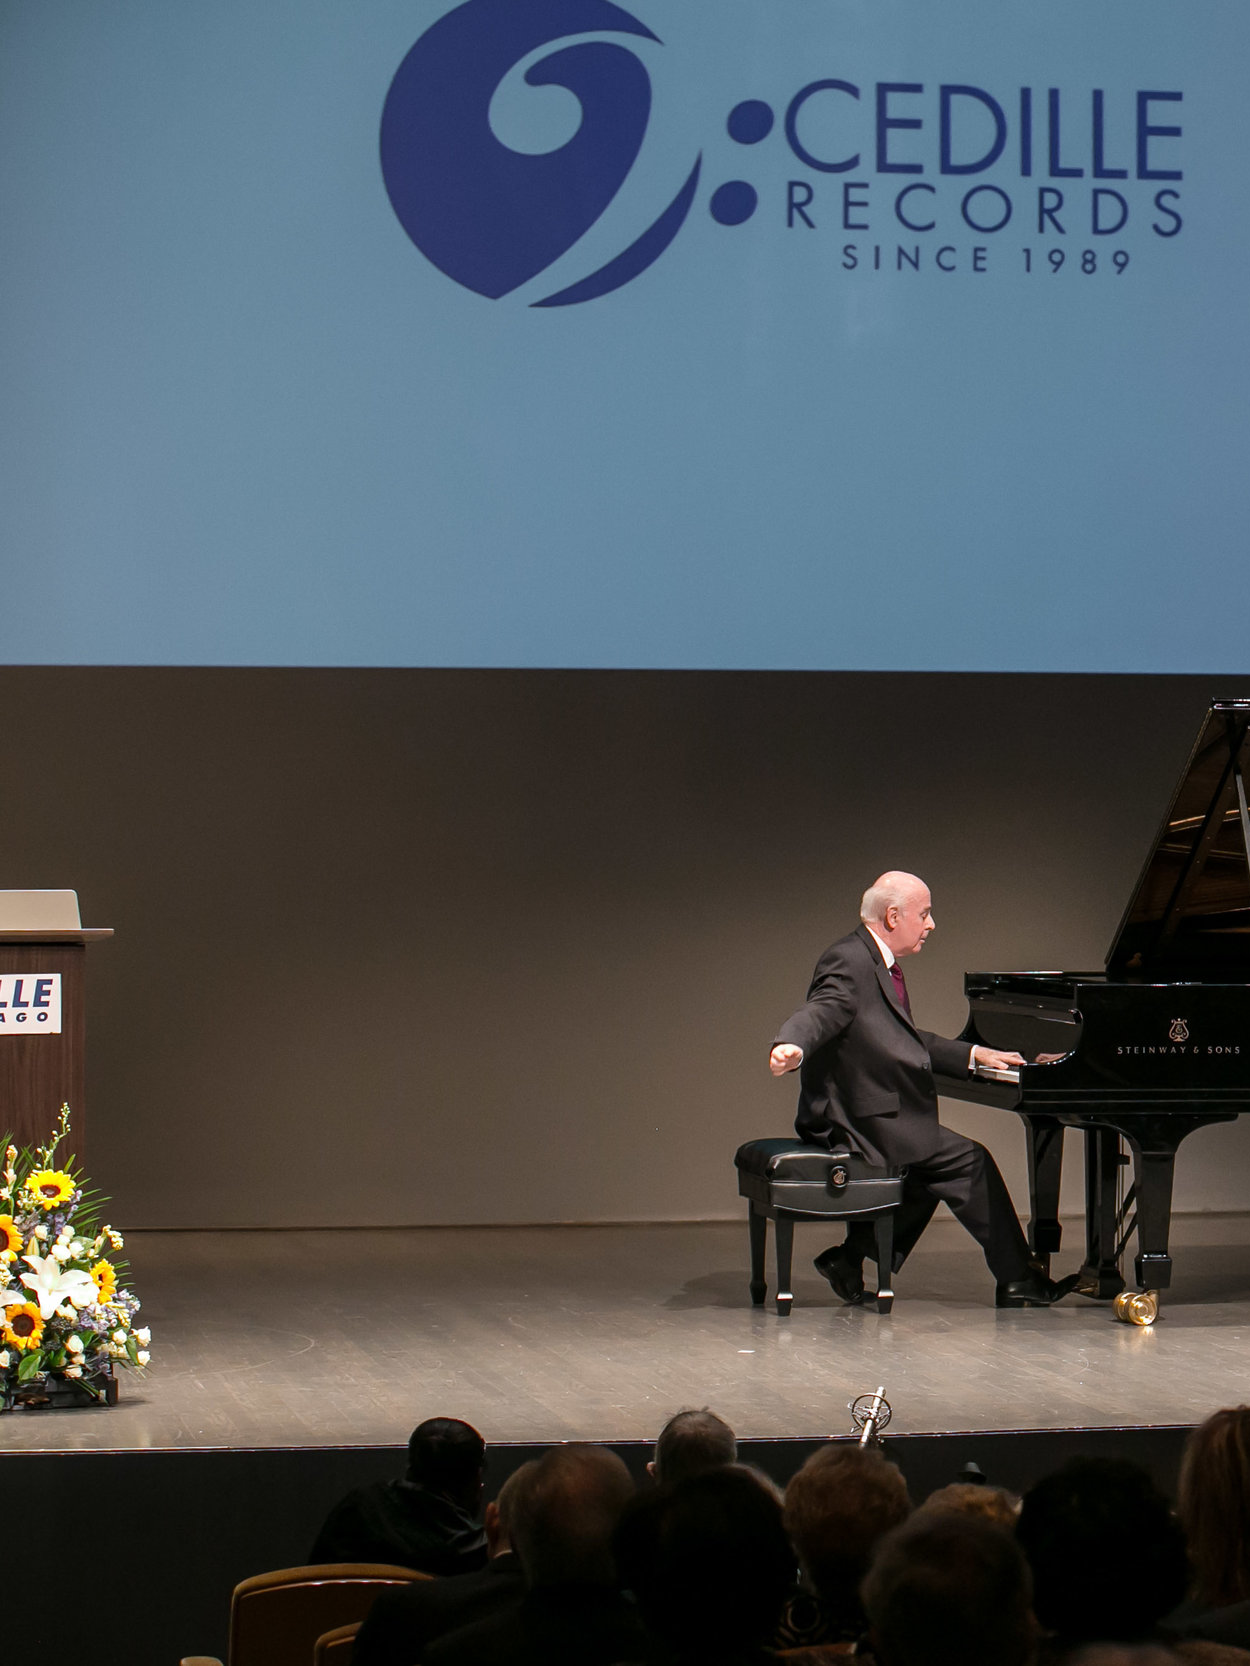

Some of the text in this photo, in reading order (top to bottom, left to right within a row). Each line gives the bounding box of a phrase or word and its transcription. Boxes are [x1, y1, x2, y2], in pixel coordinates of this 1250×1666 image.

[784, 78, 1184, 181] CEDILLE
[786, 181, 1184, 238] RECORDS
[842, 244, 1131, 276] SINCE 1989
[1117, 1045, 1241, 1055] STEINWAY & SONS
